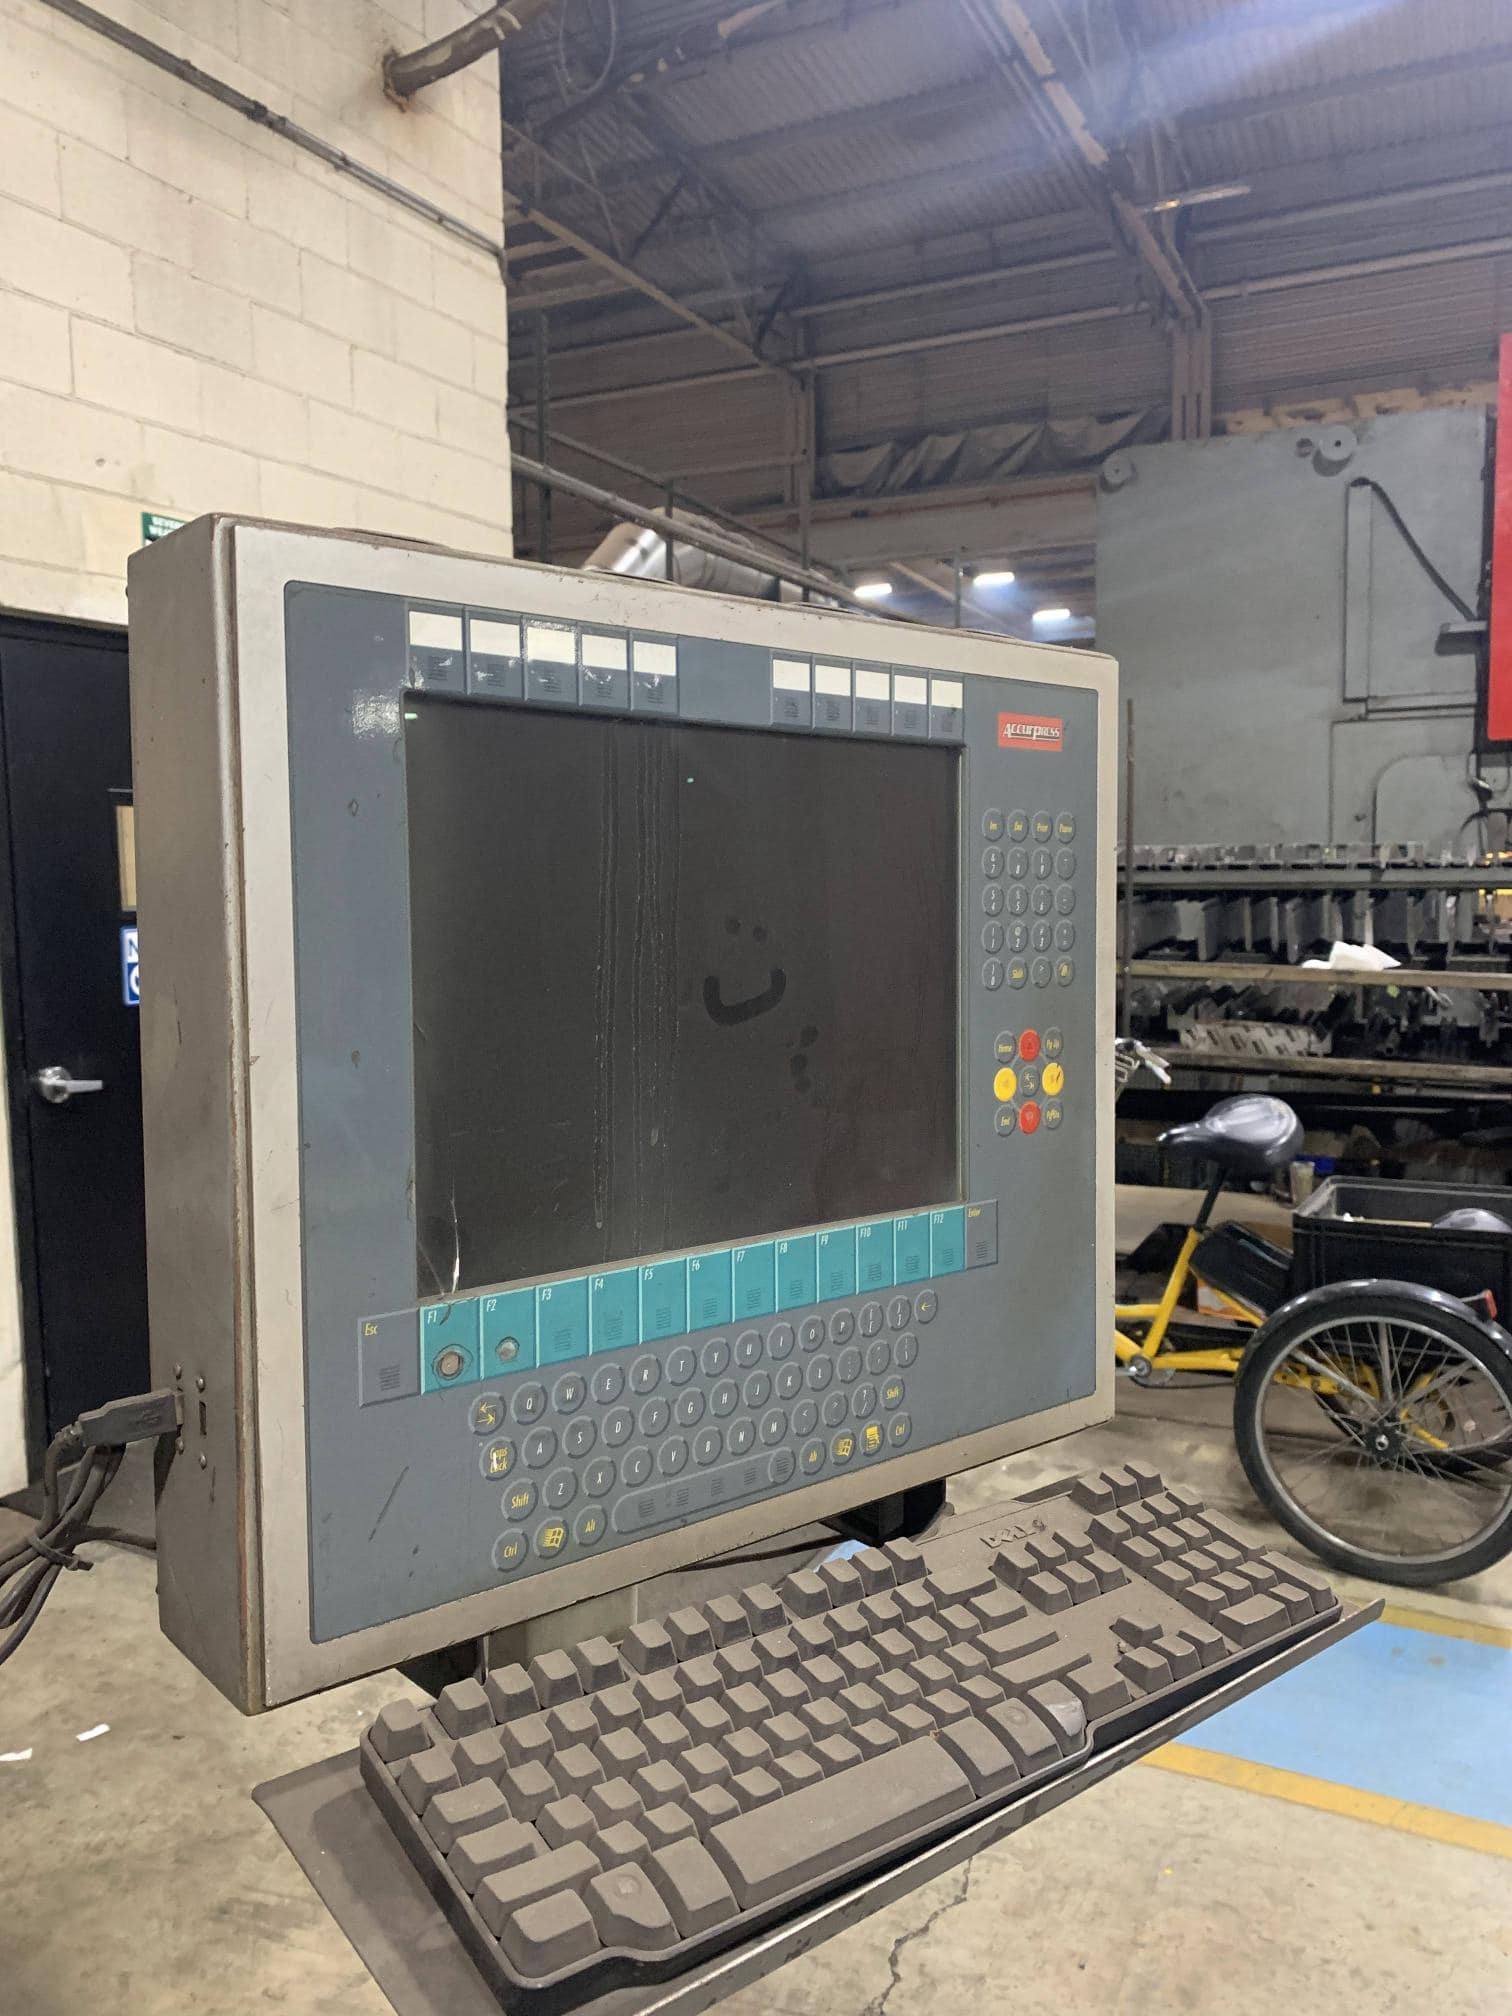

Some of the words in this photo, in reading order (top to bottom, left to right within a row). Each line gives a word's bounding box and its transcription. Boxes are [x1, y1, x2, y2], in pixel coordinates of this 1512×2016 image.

[897, 1219, 908, 1232] F11
[933, 1213, 945, 1225] F12
[820, 1233, 831, 1245] F9
[860, 1226, 872, 1238] F10
[779, 1241, 790, 1254] F8
[736, 1250, 746, 1263] F7
[691, 1258, 701, 1272] F6
[644, 1267, 654, 1281] F5
[594, 1277, 604, 1291] F4
[541, 1287, 552, 1301] F3
[486, 1298, 497, 1313] F2
[429, 1311, 438, 1325] F1
[365, 1323, 378, 1336] Esc
[566, 1387, 576, 1401] W
[512, 1493, 529, 1509] Shift
[585, 1519, 596, 1533] Alt
[504, 1543, 518, 1558] Ctrl
